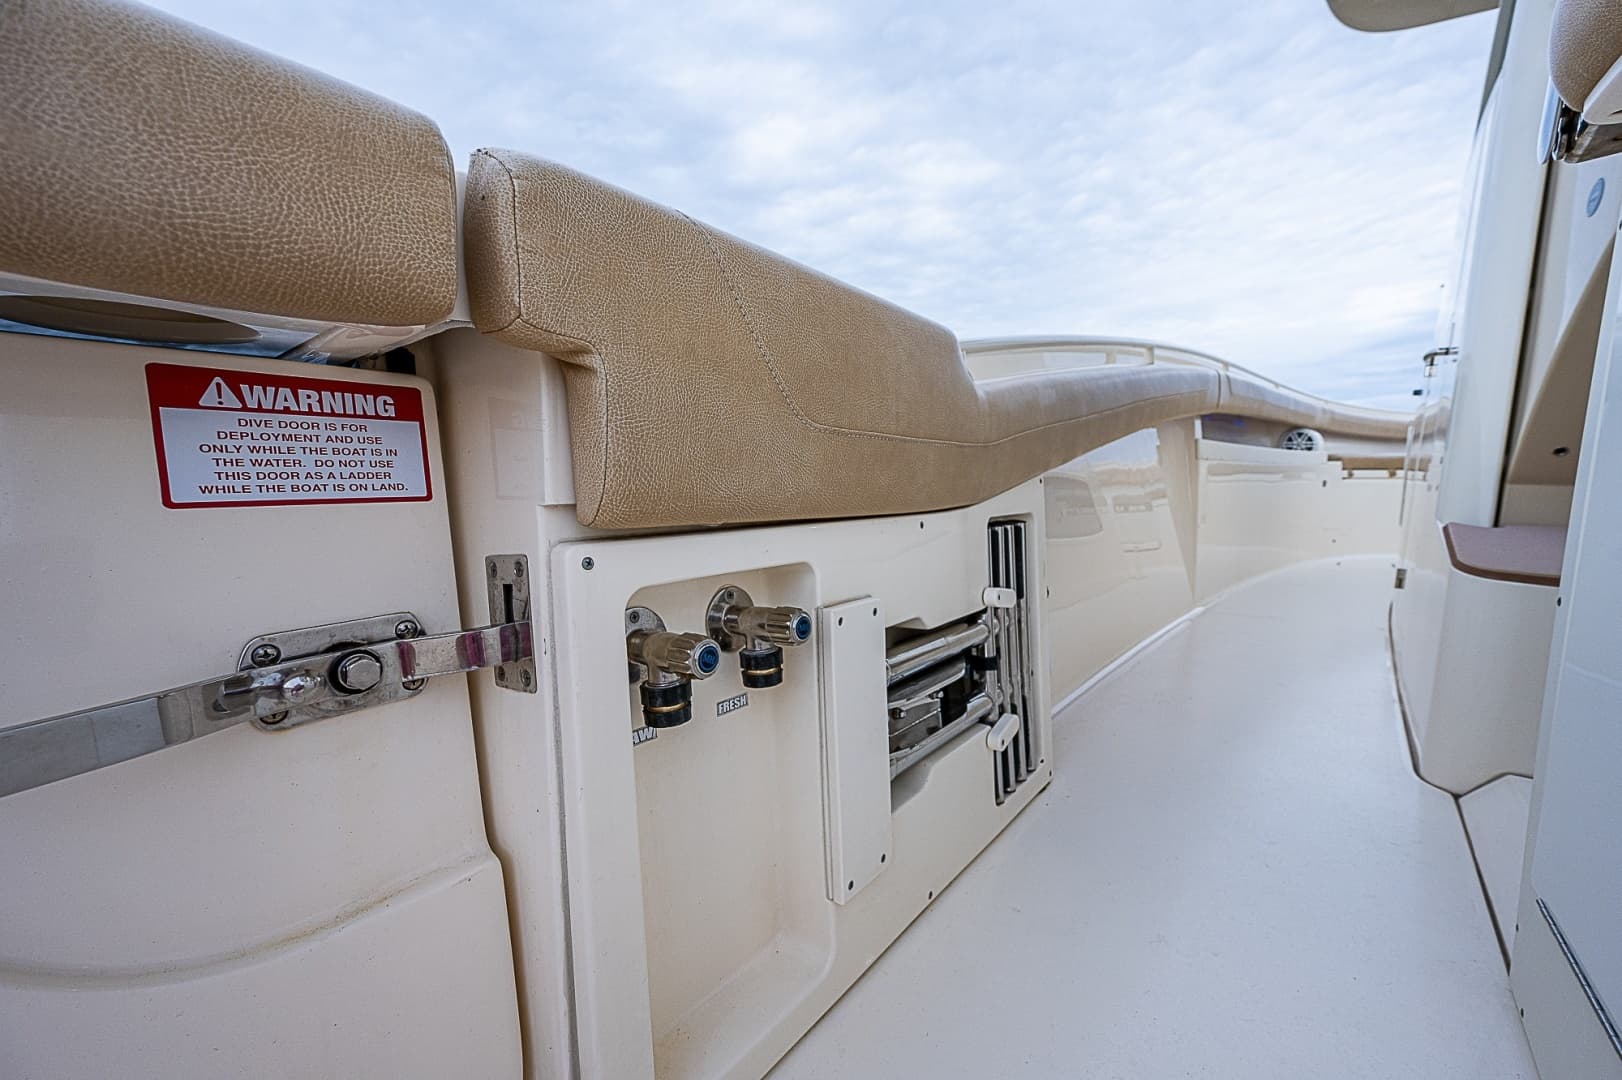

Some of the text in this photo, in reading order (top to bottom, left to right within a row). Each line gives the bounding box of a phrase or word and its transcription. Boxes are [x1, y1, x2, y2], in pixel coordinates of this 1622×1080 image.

[240, 384, 395, 417] WARNING
[238, 418, 368, 433] DIVE DOOR IS FOR
[217, 430, 382, 445] DEPLOYMENT AND USE
[199, 443, 398, 457] ONLY WHILE THE BOAT IS IN
[212, 458, 394, 468] THE WATER. DO NOT USE
[214, 471, 392, 481] THIS DOOR AS A LADDER
[198, 483, 408, 494] WHILE THE BOAT IS ON LAND.
[718, 694, 747, 714] FRESH
[632, 727, 657, 745] AW
